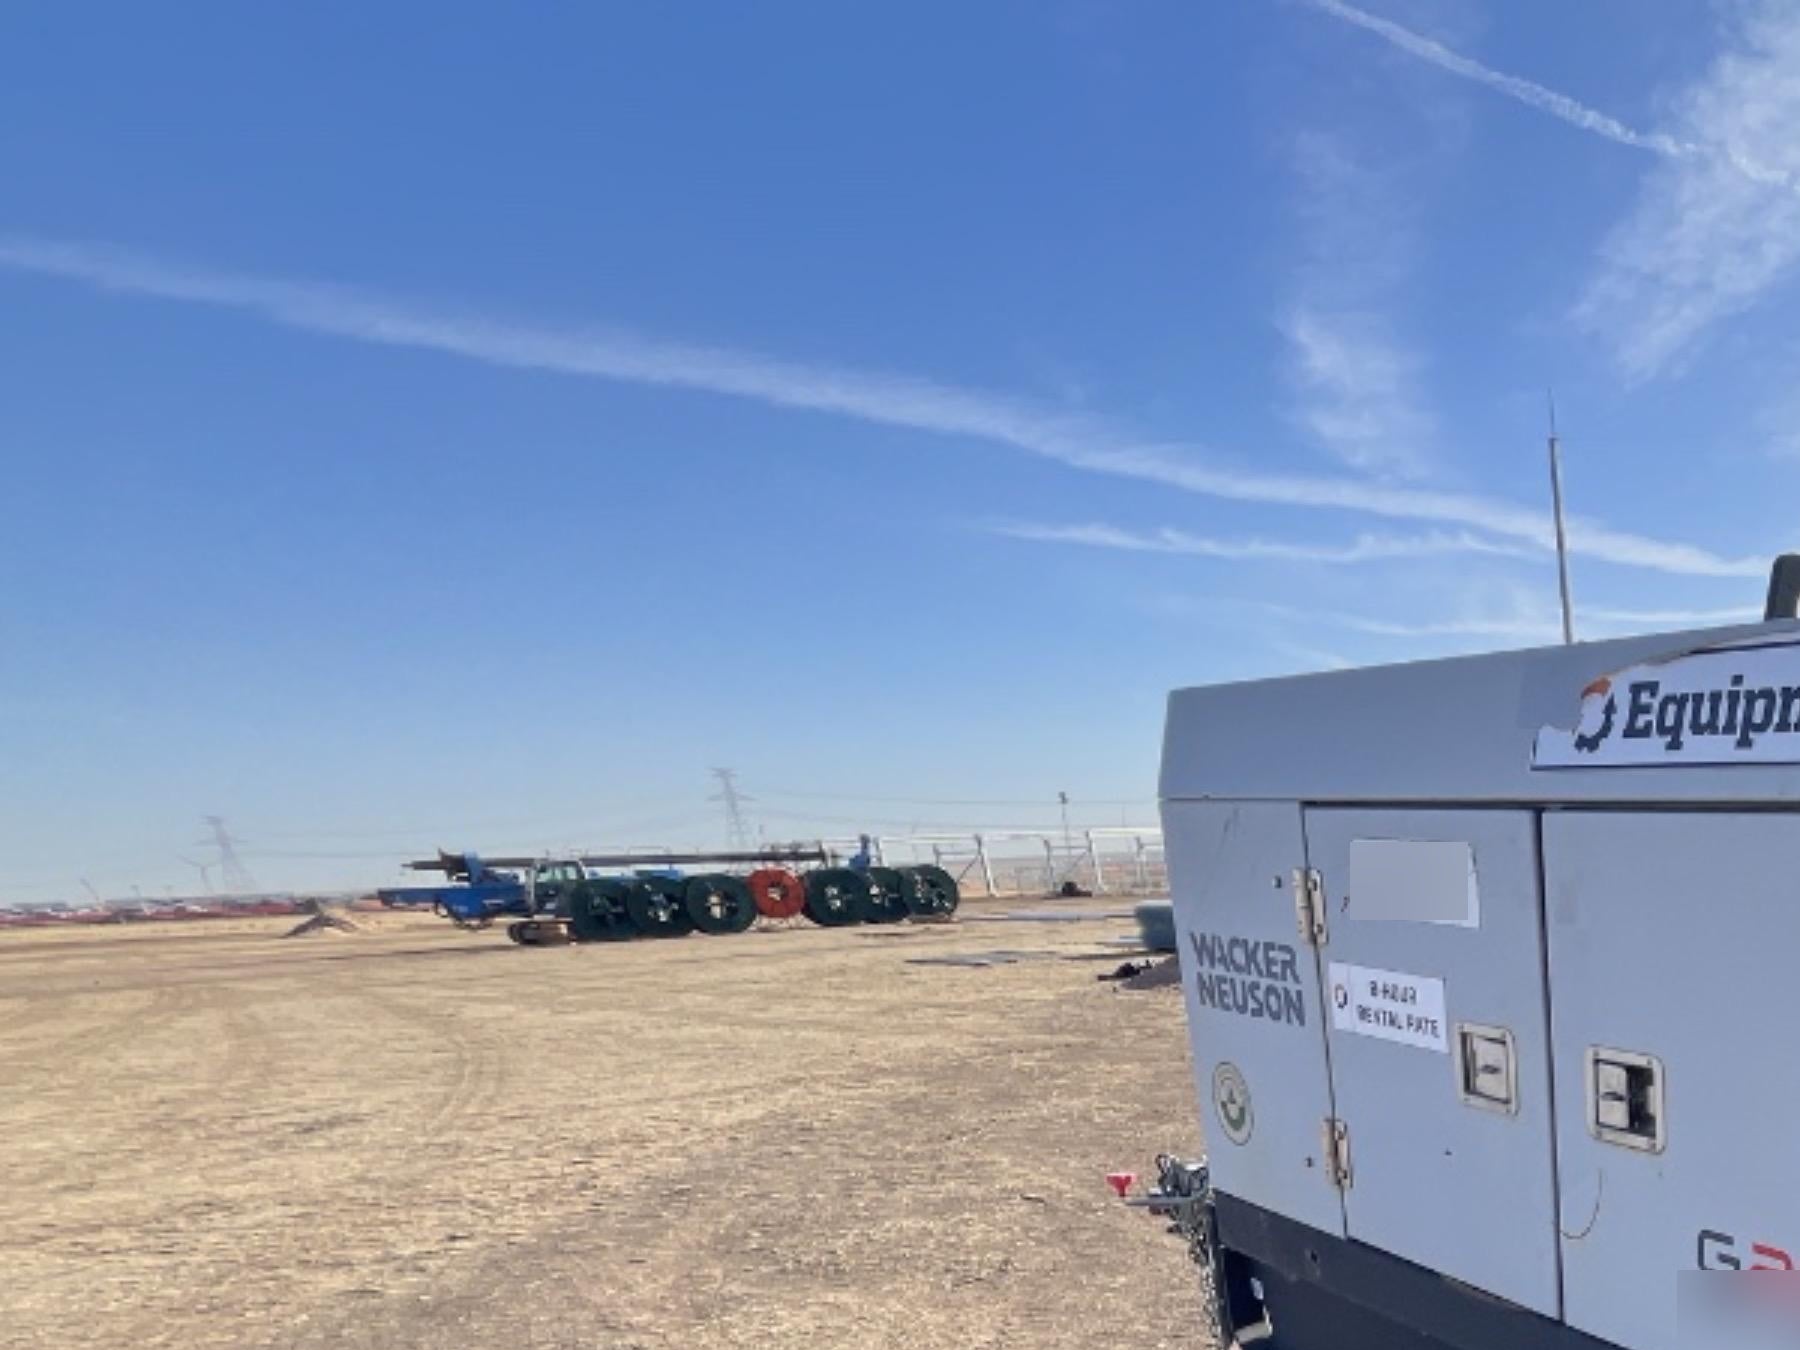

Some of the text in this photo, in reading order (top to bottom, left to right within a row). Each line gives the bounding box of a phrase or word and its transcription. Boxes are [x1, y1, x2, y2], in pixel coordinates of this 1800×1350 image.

[1189, 931, 1302, 984] WACKER
[1196, 971, 1306, 1027] NEUSON
[1406, 1013, 1441, 1039] RATE
